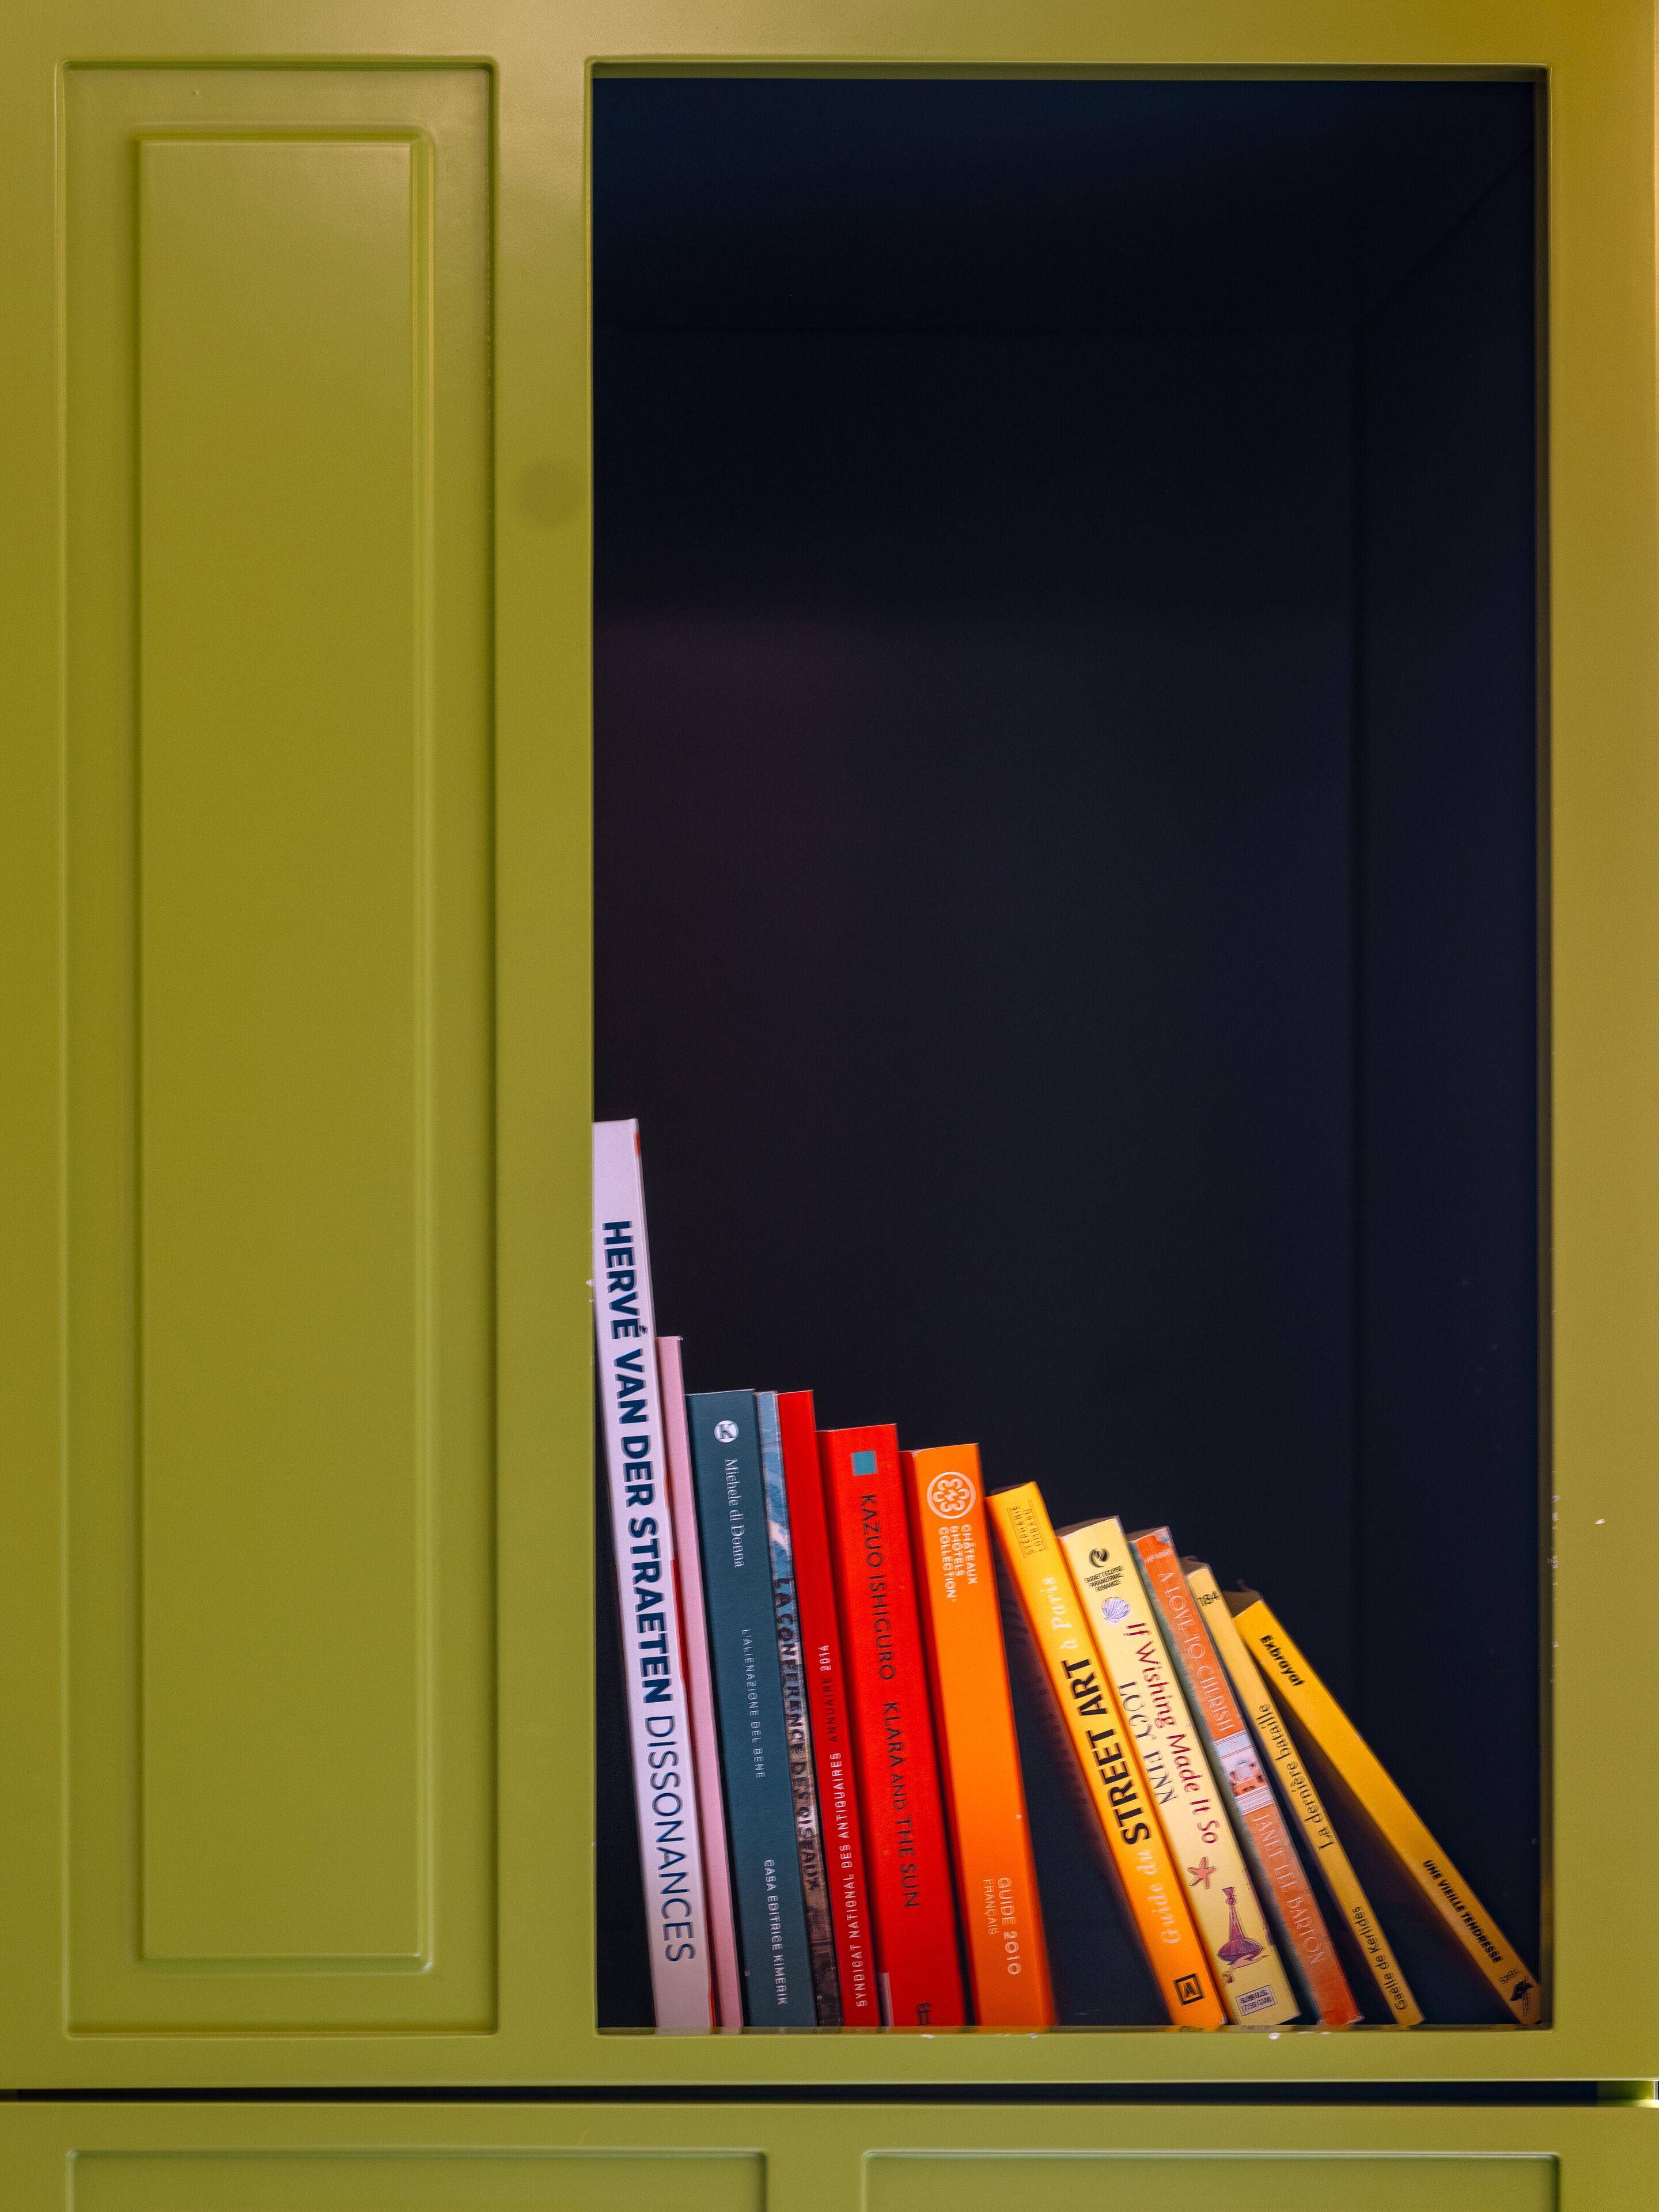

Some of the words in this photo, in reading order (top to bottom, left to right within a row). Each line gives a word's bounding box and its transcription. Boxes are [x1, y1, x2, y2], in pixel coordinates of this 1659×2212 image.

[603, 1221, 647, 1339] HERVÉ
[613, 1349, 648, 1424] VAN
[621, 1435, 656, 1506] DER
[724, 1458, 739, 1506] Michele
[730, 1510, 744, 1522] di
[861, 1493, 882, 1569] KAZUO
[1010, 1506, 1033, 1555] STÉPHANIE
[1024, 1508, 1045, 1552] LOMBARD
[731, 1525, 745, 1567] Donna
[938, 1527, 956, 1598] COLLECTION
[961, 1524, 978, 1585] CHÂTEAUX
[774, 1577, 791, 1609] LA
[1088, 1571, 1124, 1588] PARANORMAL
[1094, 1578, 1122, 1593] ROMANCE
[1158, 1572, 1175, 1582] A
[628, 1516, 673, 1703] STRAETEN
[869, 1575, 894, 1681] ISHIGURO
[1042, 1577, 1070, 1631] Paris
[1165, 1587, 1195, 1631] LOVE
[1123, 1622, 1151, 1637] If
[1184, 1634, 1205, 1659] TO
[741, 1629, 760, 1717] L'ALIENAZIONE
[819, 1645, 832, 1671] 2014
[1259, 1635, 1304, 1686] Exbrayat
[821, 1677, 838, 1743] ANNUAIRE
[1060, 1658, 1108, 1716] ART
[1135, 1642, 1176, 1728] Wishing
[1198, 1665, 1235, 1732] CHERISH
[750, 1721, 762, 1744] DEL
[882, 1702, 906, 1768] KLARA
[1117, 1681, 1155, 1739] LUCY
[1142, 1749, 1177, 1804] FINN
[1257, 1705, 1291, 1760] bataille
[753, 1748, 766, 1779] BENE
[791, 1762, 811, 1801] DES
[1088, 1729, 1151, 1846] STREET
[1167, 1733, 1202, 1792] Made
[830, 1752, 849, 1839] ANTIQUAIRES
[889, 1772, 904, 1810] AND
[1189, 1798, 1211, 1816] It
[1287, 1761, 1323, 1823] dernière
[645, 1716, 694, 1963] DISSONANCES
[797, 1806, 821, 1891] OISEAUX
[839, 1844, 853, 1869] DES
[894, 1817, 913, 1857] THE
[1198, 1820, 1219, 1843] So
[1318, 1825, 1335, 1850] La
[764, 1859, 778, 1891] CASA
[901, 1863, 919, 1908] SUN
[1136, 1849, 1157, 1876] du
[842, 1873, 861, 1938] NATIONAL
[997, 1877, 1016, 1926] GUIDE
[1147, 1883, 1180, 1944] Guide
[1251, 1813, 1285, 1859] JANET
[1273, 1863, 1298, 1893] LEE
[1286, 1896, 1325, 1965] BARTON
[1423, 1860, 1441, 1880] UNE
[1439, 1879, 1465, 1912] VIEILLE
[1461, 1912, 1502, 1963] TENDRESSE
[767, 1896, 783, 1951] EDITRICE
[849, 1945, 868, 2007] SYNDICAT
[1003, 1931, 1022, 1975] 2010
[1375, 1955, 1389, 1969] de
[772, 1955, 787, 2005] KIMERIK
[1383, 1973, 1407, 2010] Gaëlle
